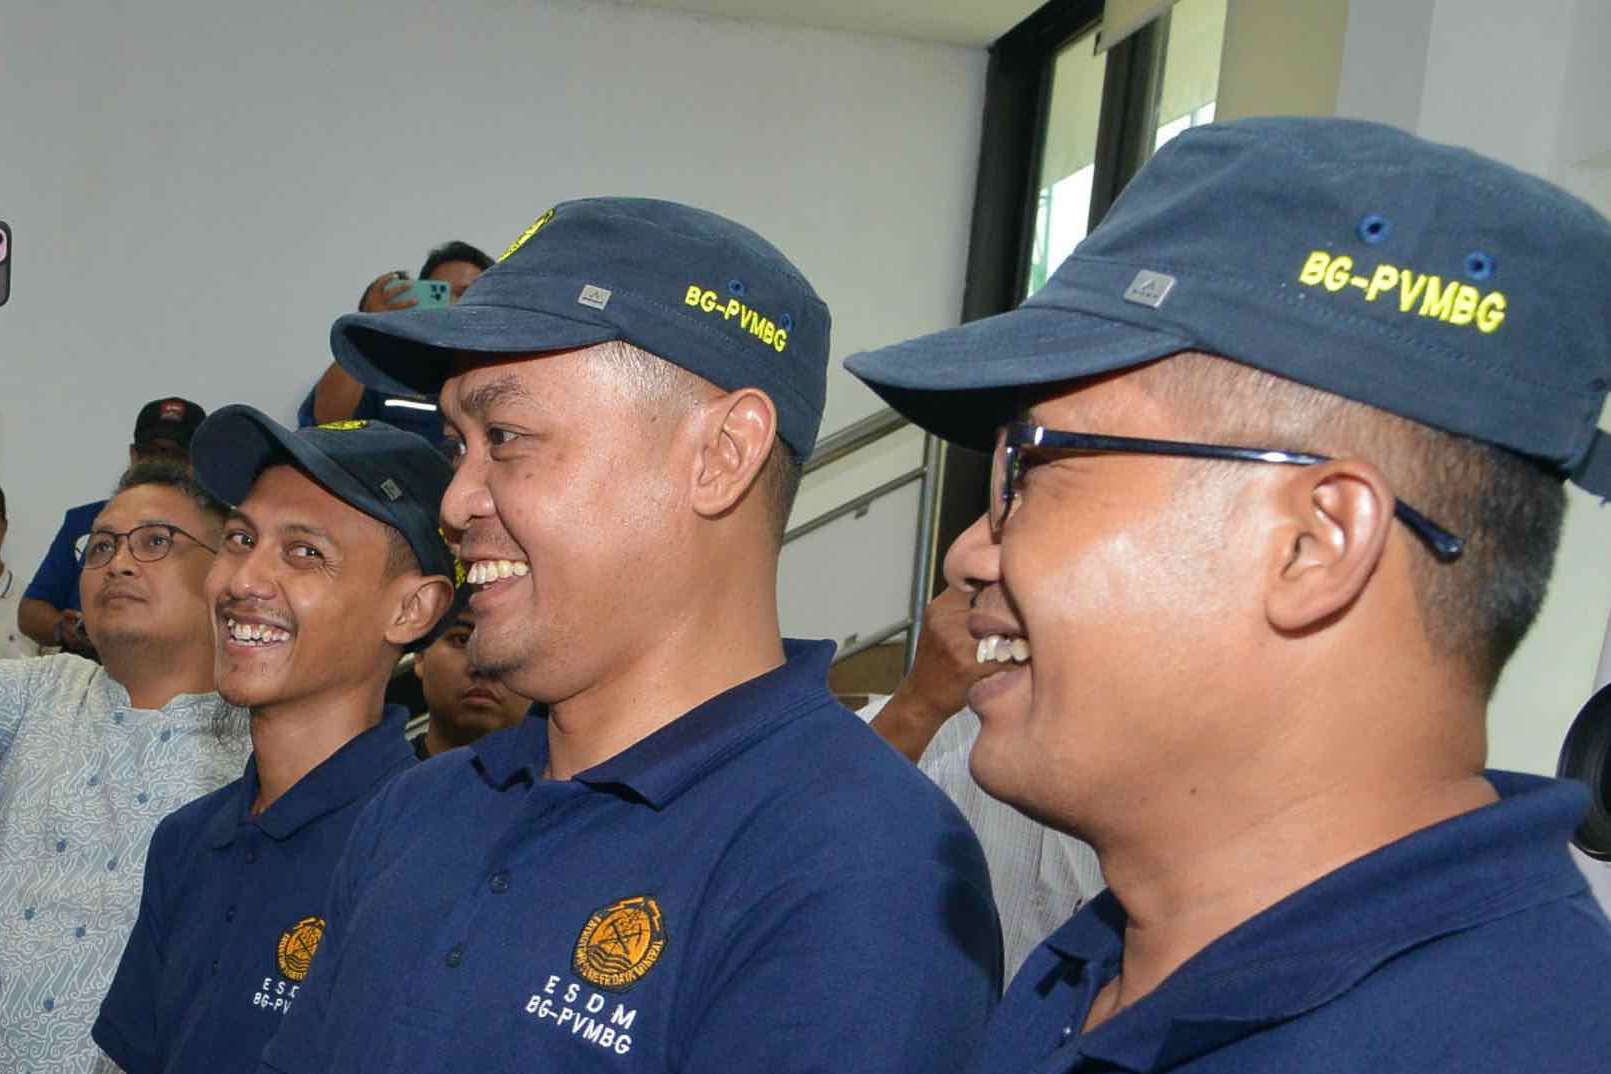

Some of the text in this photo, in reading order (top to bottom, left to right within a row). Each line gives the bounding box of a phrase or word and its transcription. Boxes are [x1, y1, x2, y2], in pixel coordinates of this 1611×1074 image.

[685, 285, 788, 352] BG-PVMBG
[1297, 249, 1507, 333] BG-PVMBG
[525, 995, 632, 1055] BG-PVMBG
